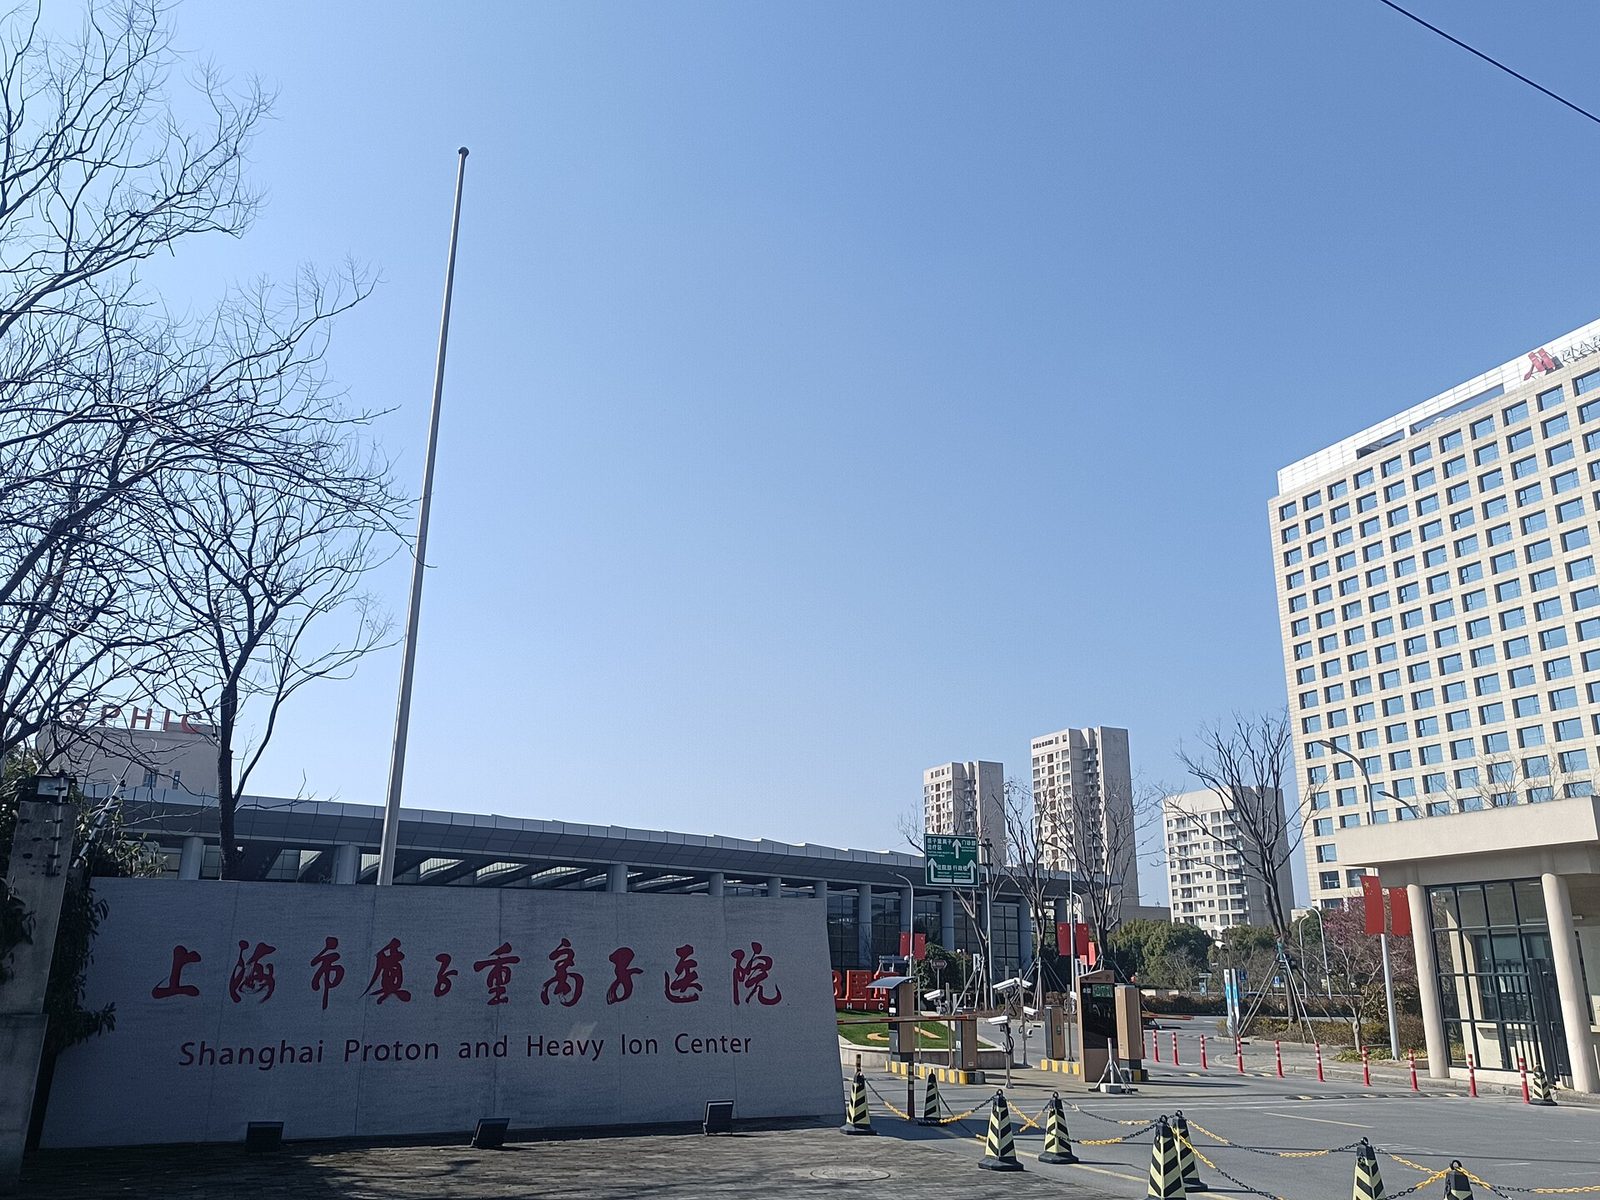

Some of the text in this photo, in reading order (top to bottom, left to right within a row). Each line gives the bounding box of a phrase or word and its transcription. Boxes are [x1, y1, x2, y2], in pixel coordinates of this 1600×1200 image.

[151, 936, 783, 1010] 上海市质子重离子医院
[178, 1033, 752, 1071] Shanghai Proton and Heavy Ion Center
